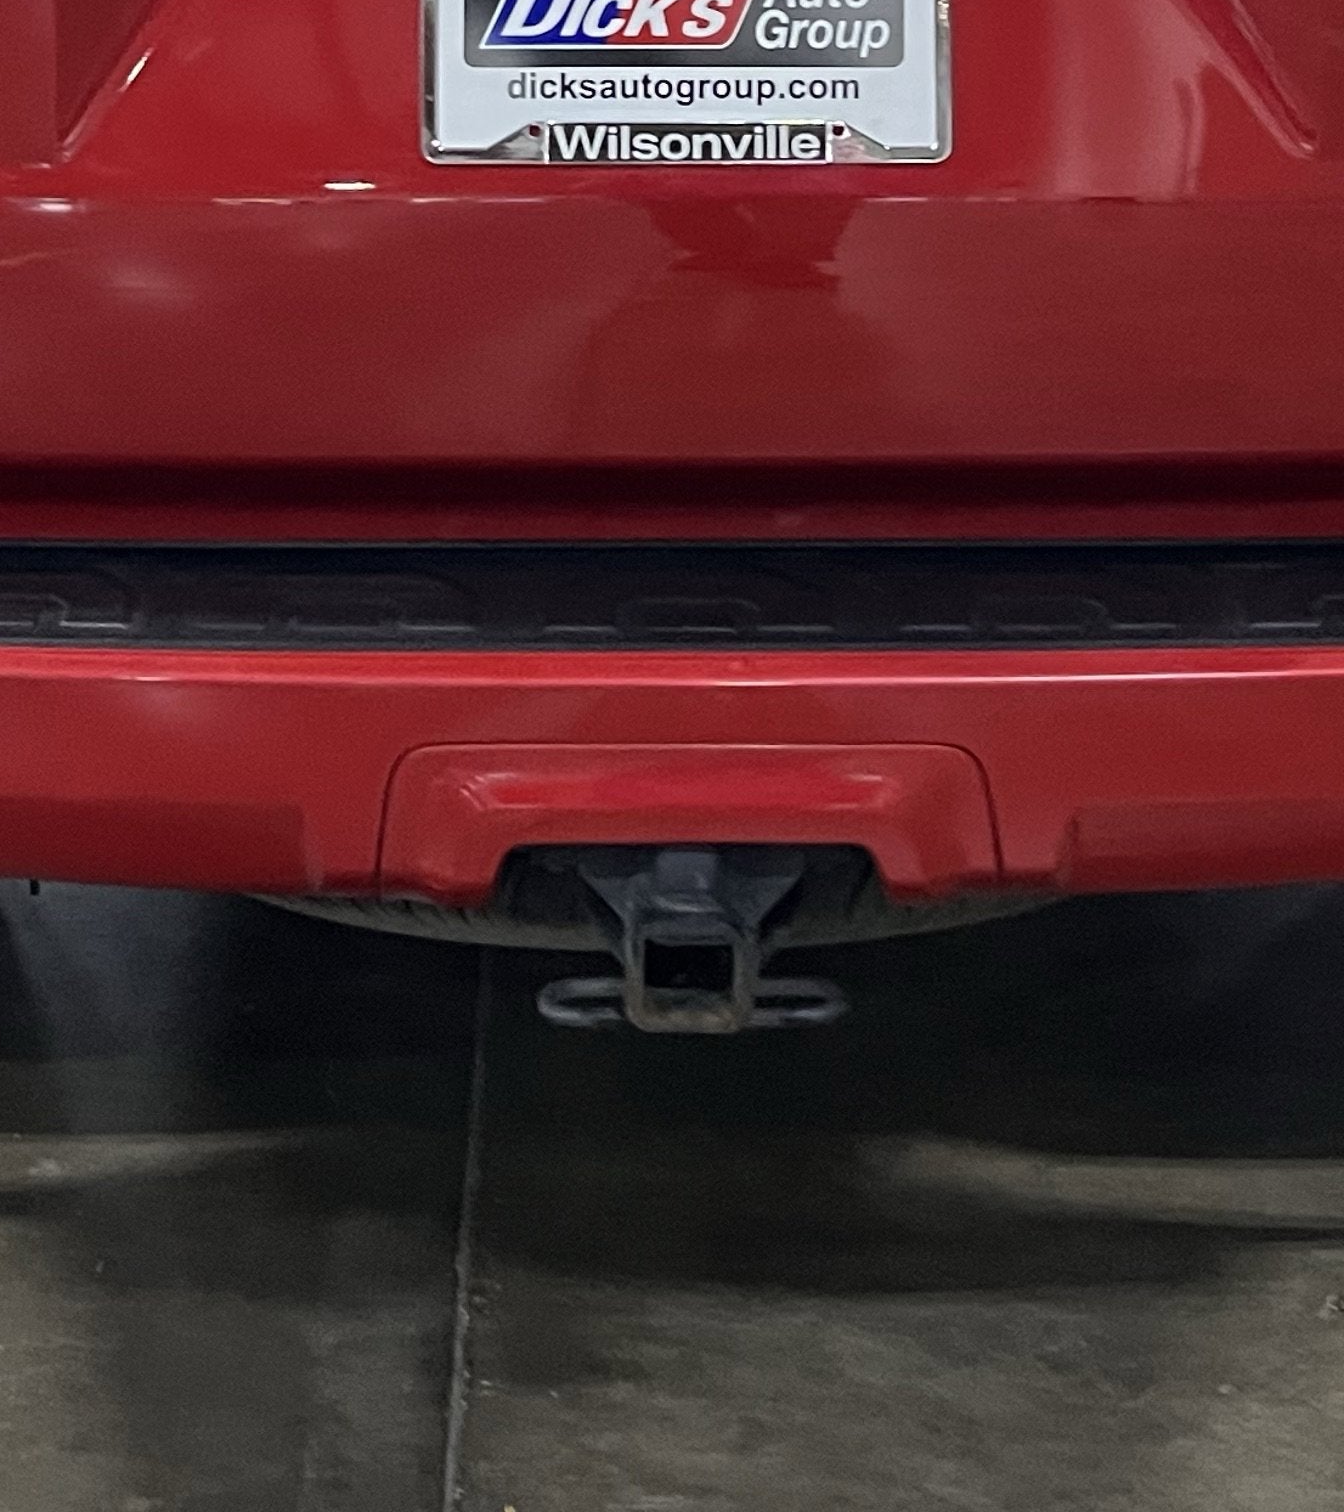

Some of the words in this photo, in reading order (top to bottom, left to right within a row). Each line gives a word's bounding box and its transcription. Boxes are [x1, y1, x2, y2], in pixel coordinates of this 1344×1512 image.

[756, 9, 891, 57] Group
[507, 73, 860, 106] dicksautogroup.com
[555, 124, 822, 161] Wilsonville
